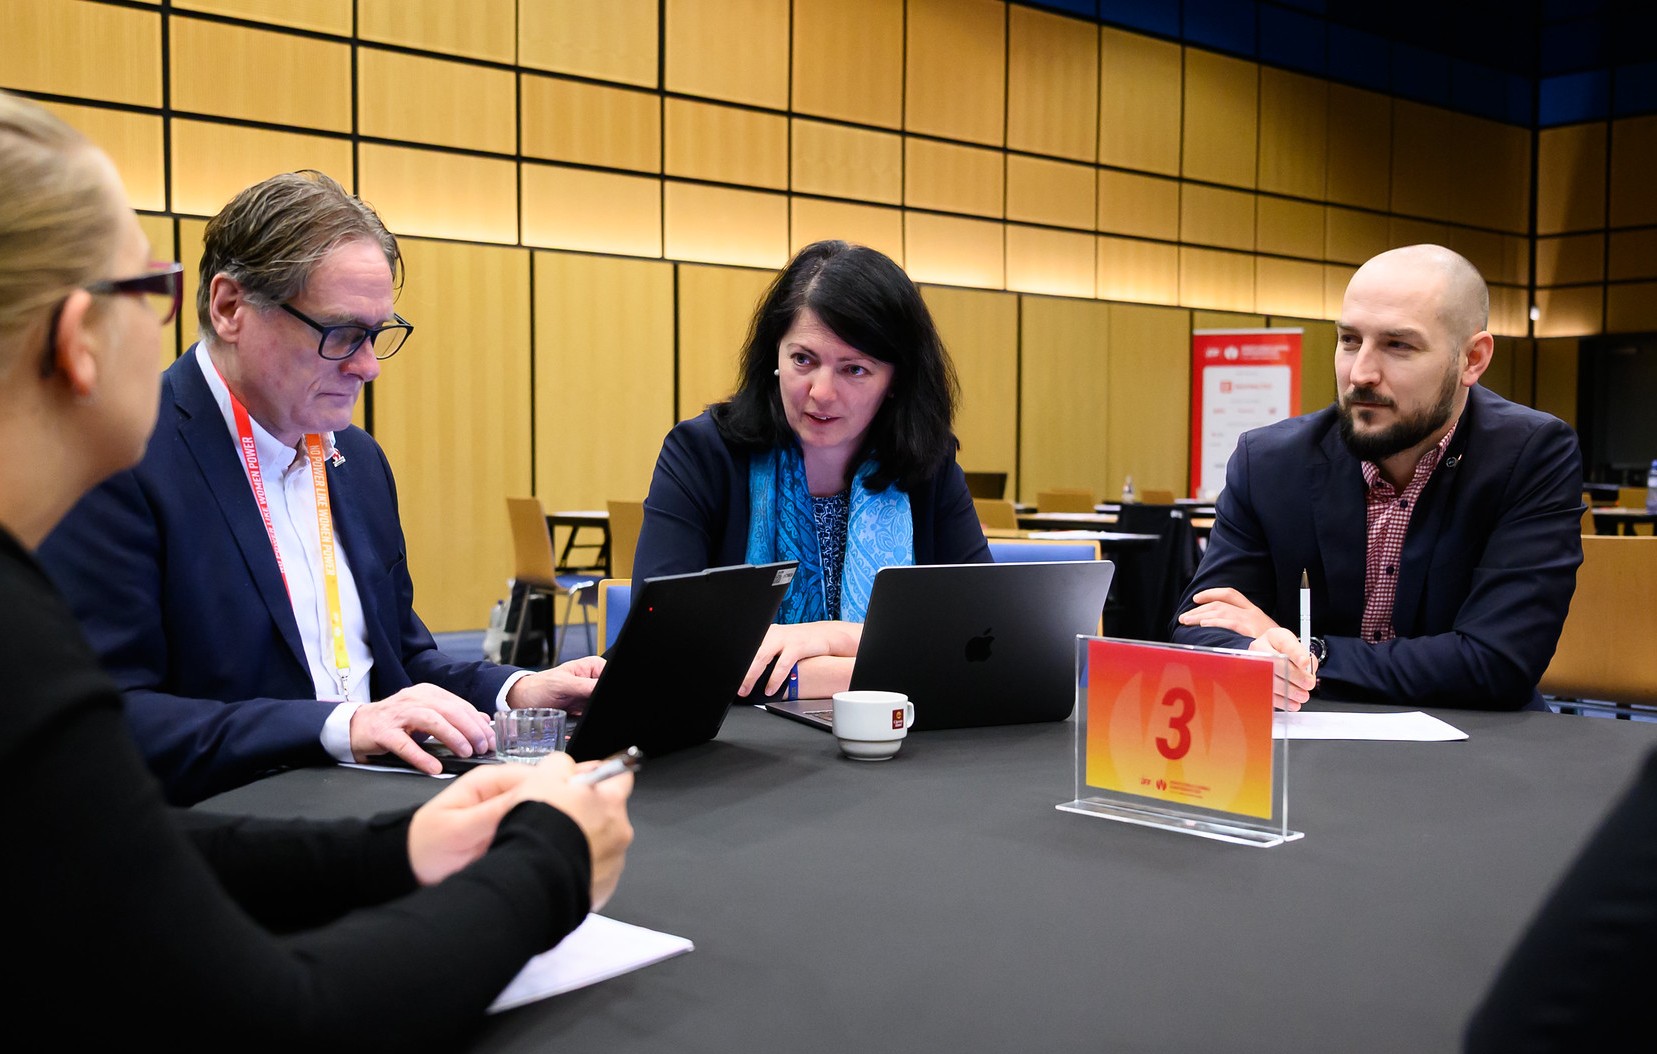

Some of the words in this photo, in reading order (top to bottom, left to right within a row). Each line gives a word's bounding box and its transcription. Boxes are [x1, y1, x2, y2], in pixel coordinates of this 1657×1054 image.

[242, 436, 258, 469] POWER
[310, 445, 321, 455] NO
[312, 456, 325, 486] POWER
[252, 472, 267, 505] WOMEN
[316, 487, 327, 507] LIKE
[262, 506, 274, 527] LIKE
[319, 509, 331, 543] WOMEN
[1155, 687, 1196, 760] 3
